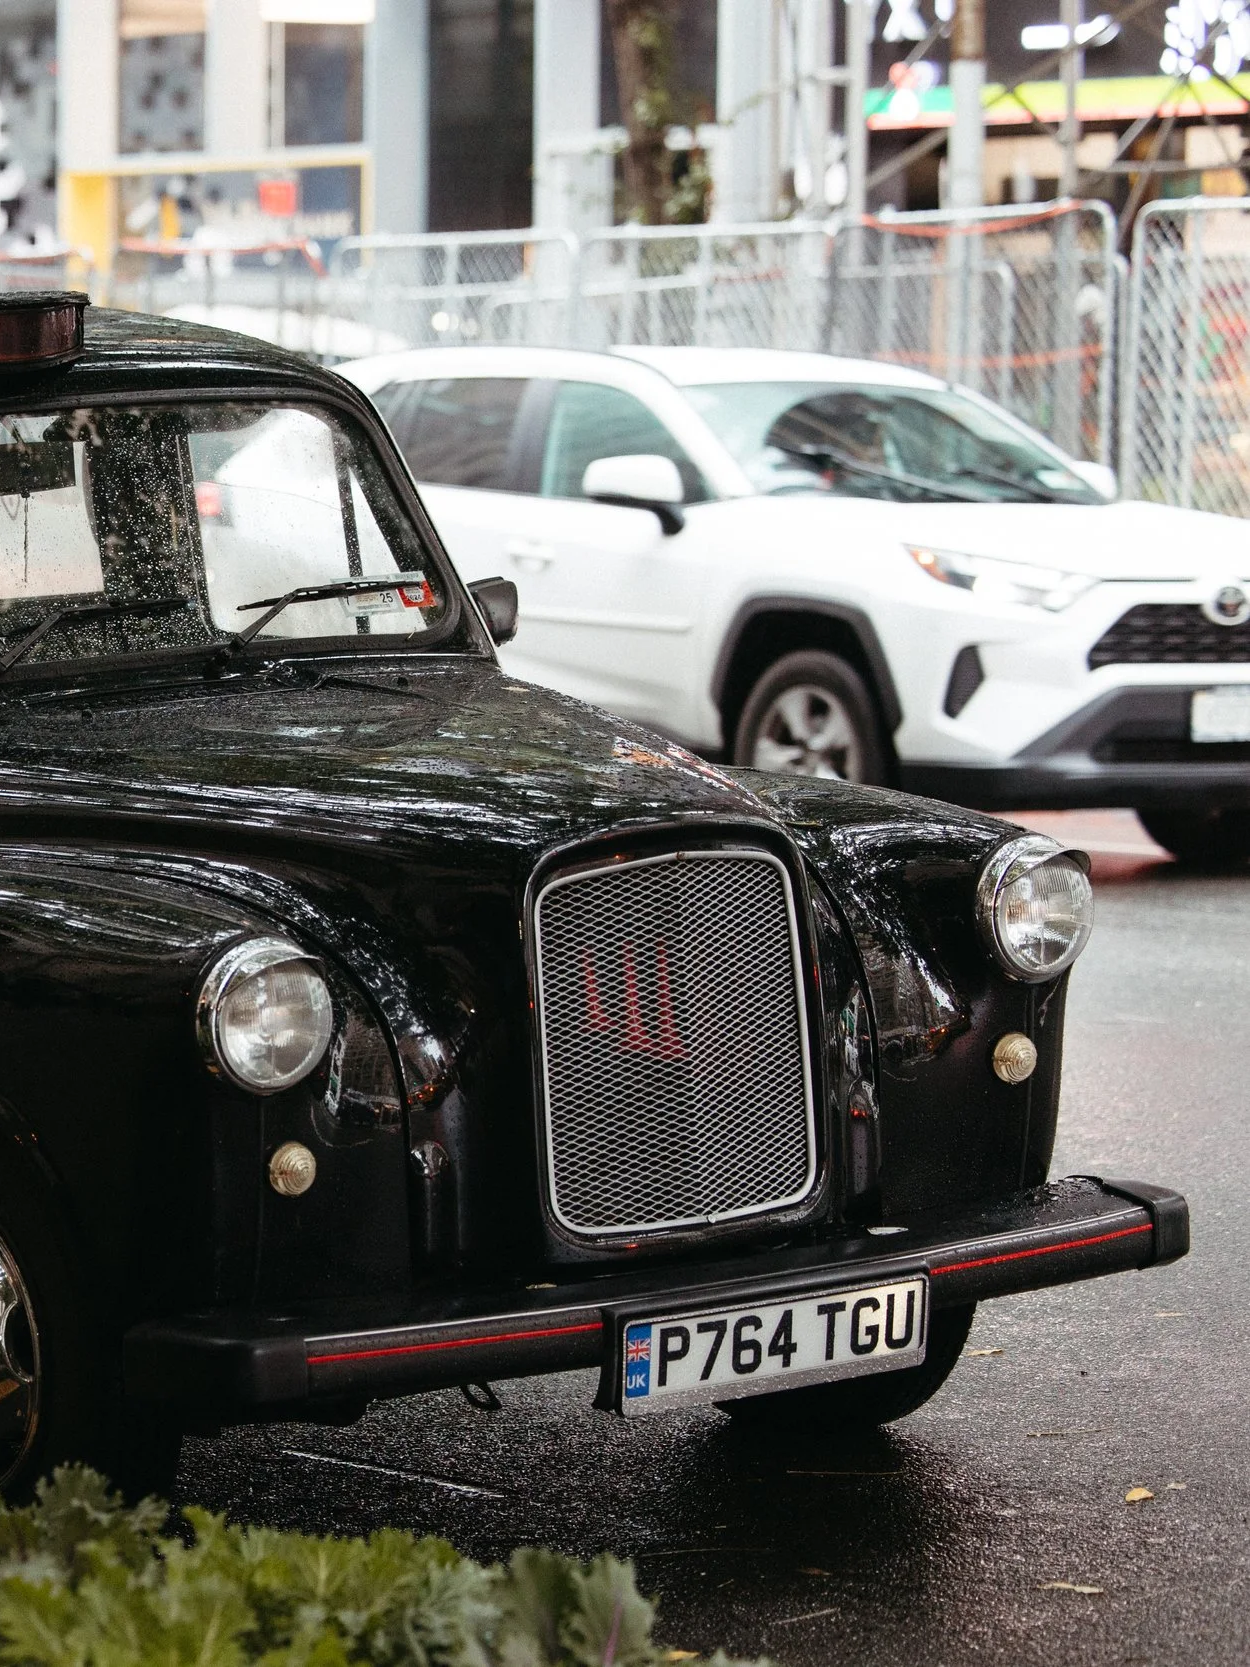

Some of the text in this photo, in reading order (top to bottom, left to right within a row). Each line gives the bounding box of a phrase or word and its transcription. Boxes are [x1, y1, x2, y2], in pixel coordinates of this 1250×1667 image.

[379, 592, 393, 603] 25
[657, 1290, 915, 1388] P764 TGU
[626, 1374, 646, 1389] UK
